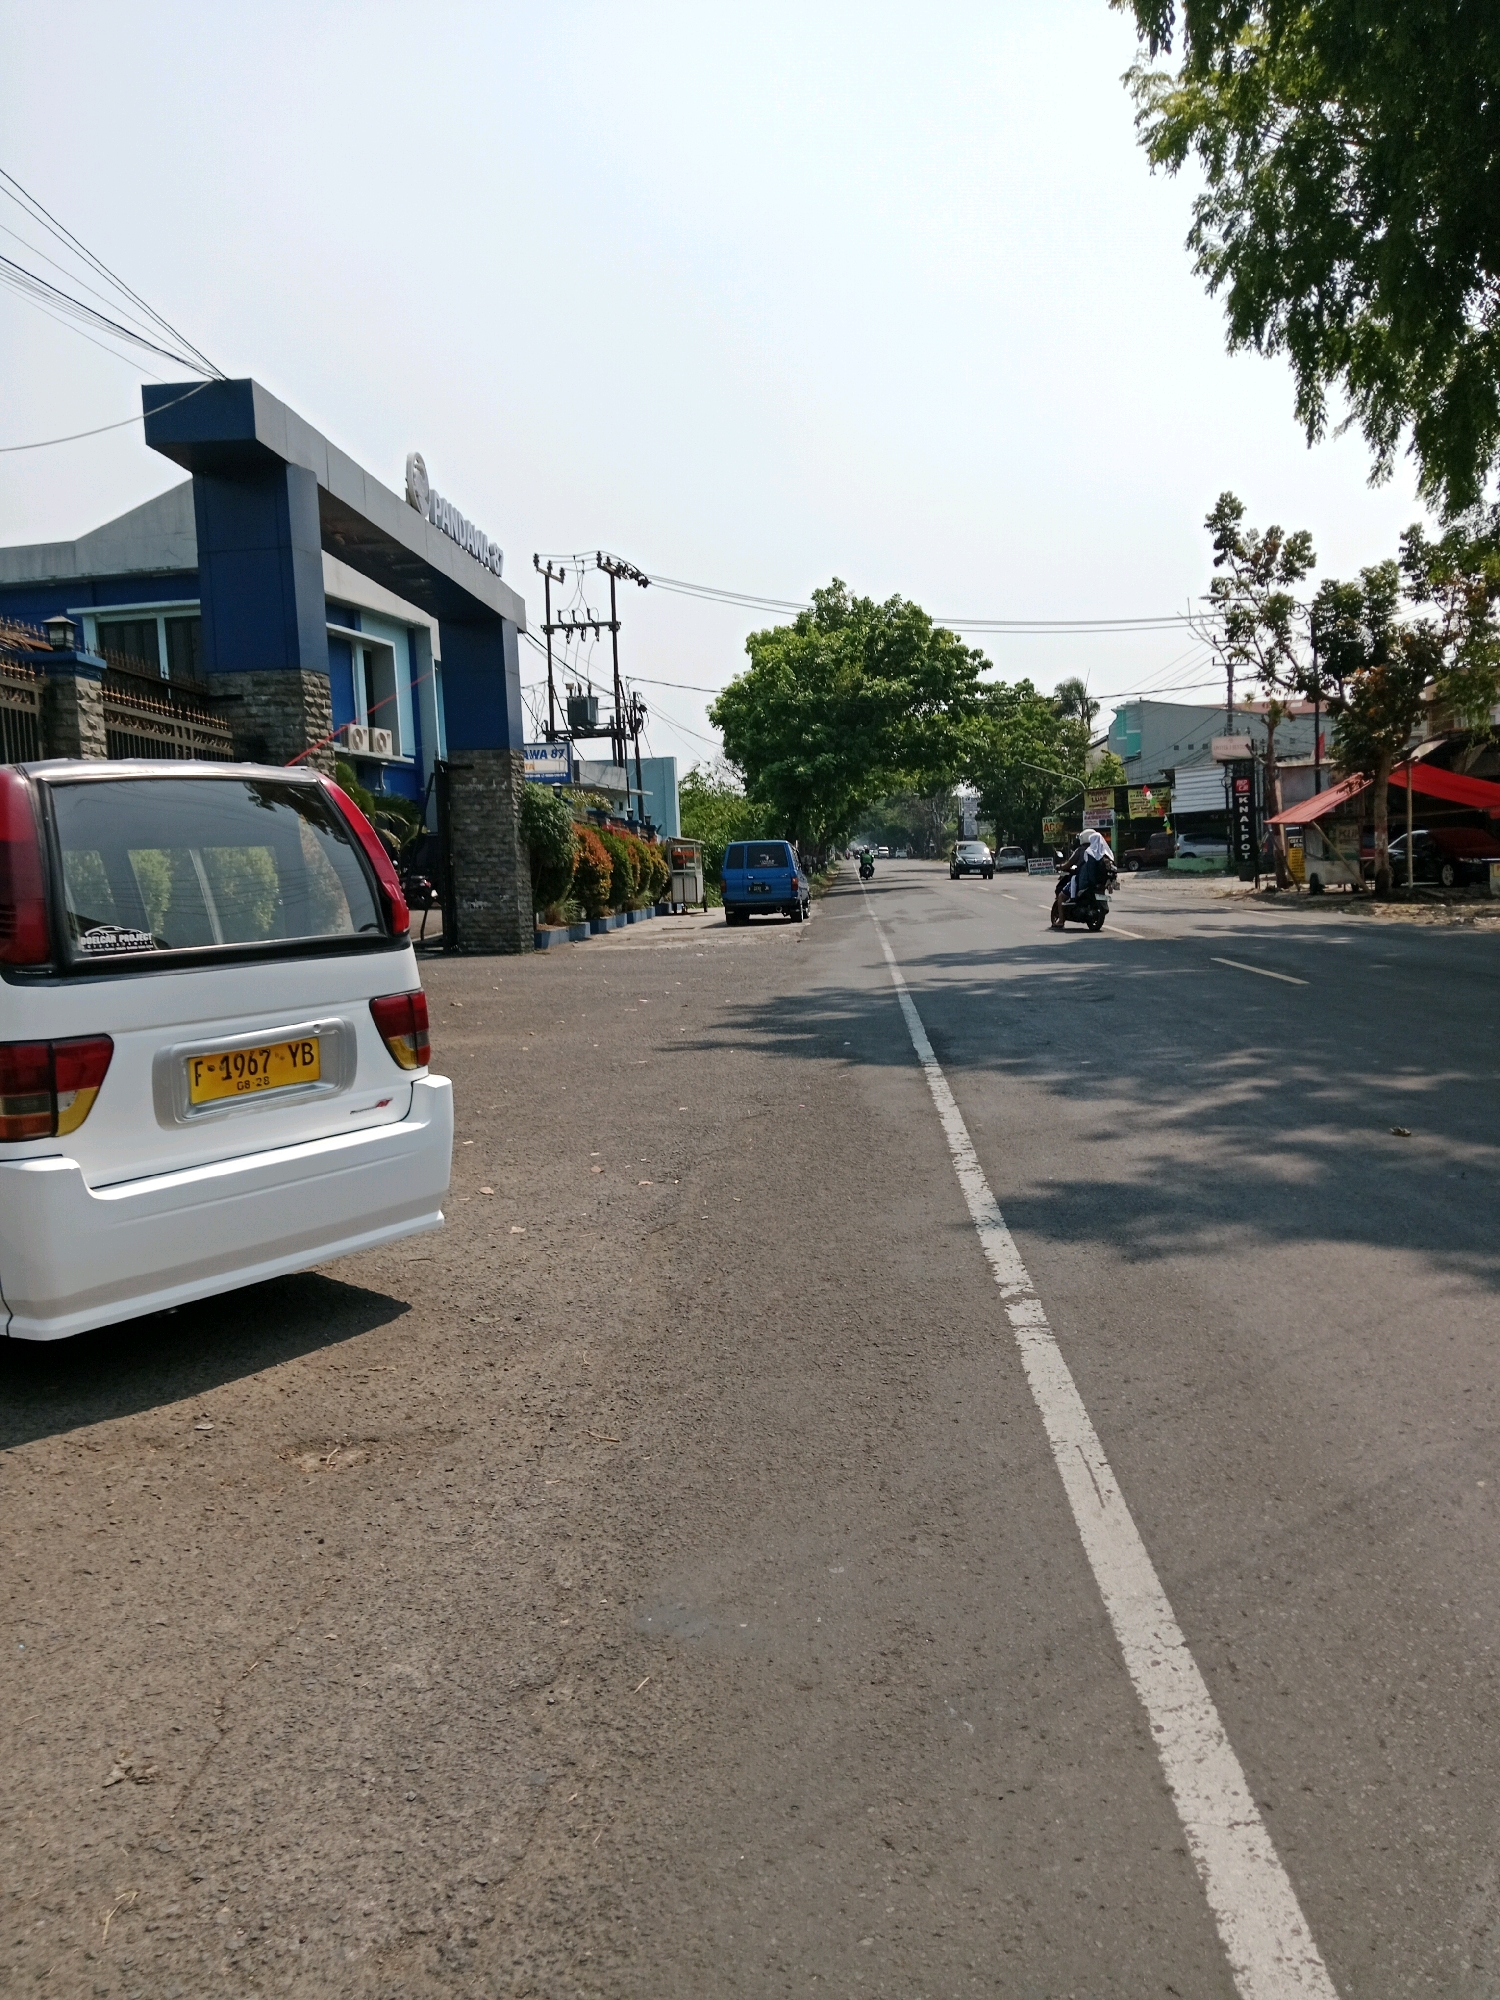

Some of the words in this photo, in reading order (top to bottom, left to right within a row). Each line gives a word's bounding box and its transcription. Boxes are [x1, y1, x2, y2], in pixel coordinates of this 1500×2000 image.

[429, 489, 491, 568] PANDAWA
[550, 748, 565, 759] 87
[1238, 796, 1250, 860] KNALPOT
[118, 932, 152, 943] PROJECT
[194, 1060, 204, 1087] F
[220, 1047, 271, 1081] 1967
[287, 1042, 314, 1067] YB
